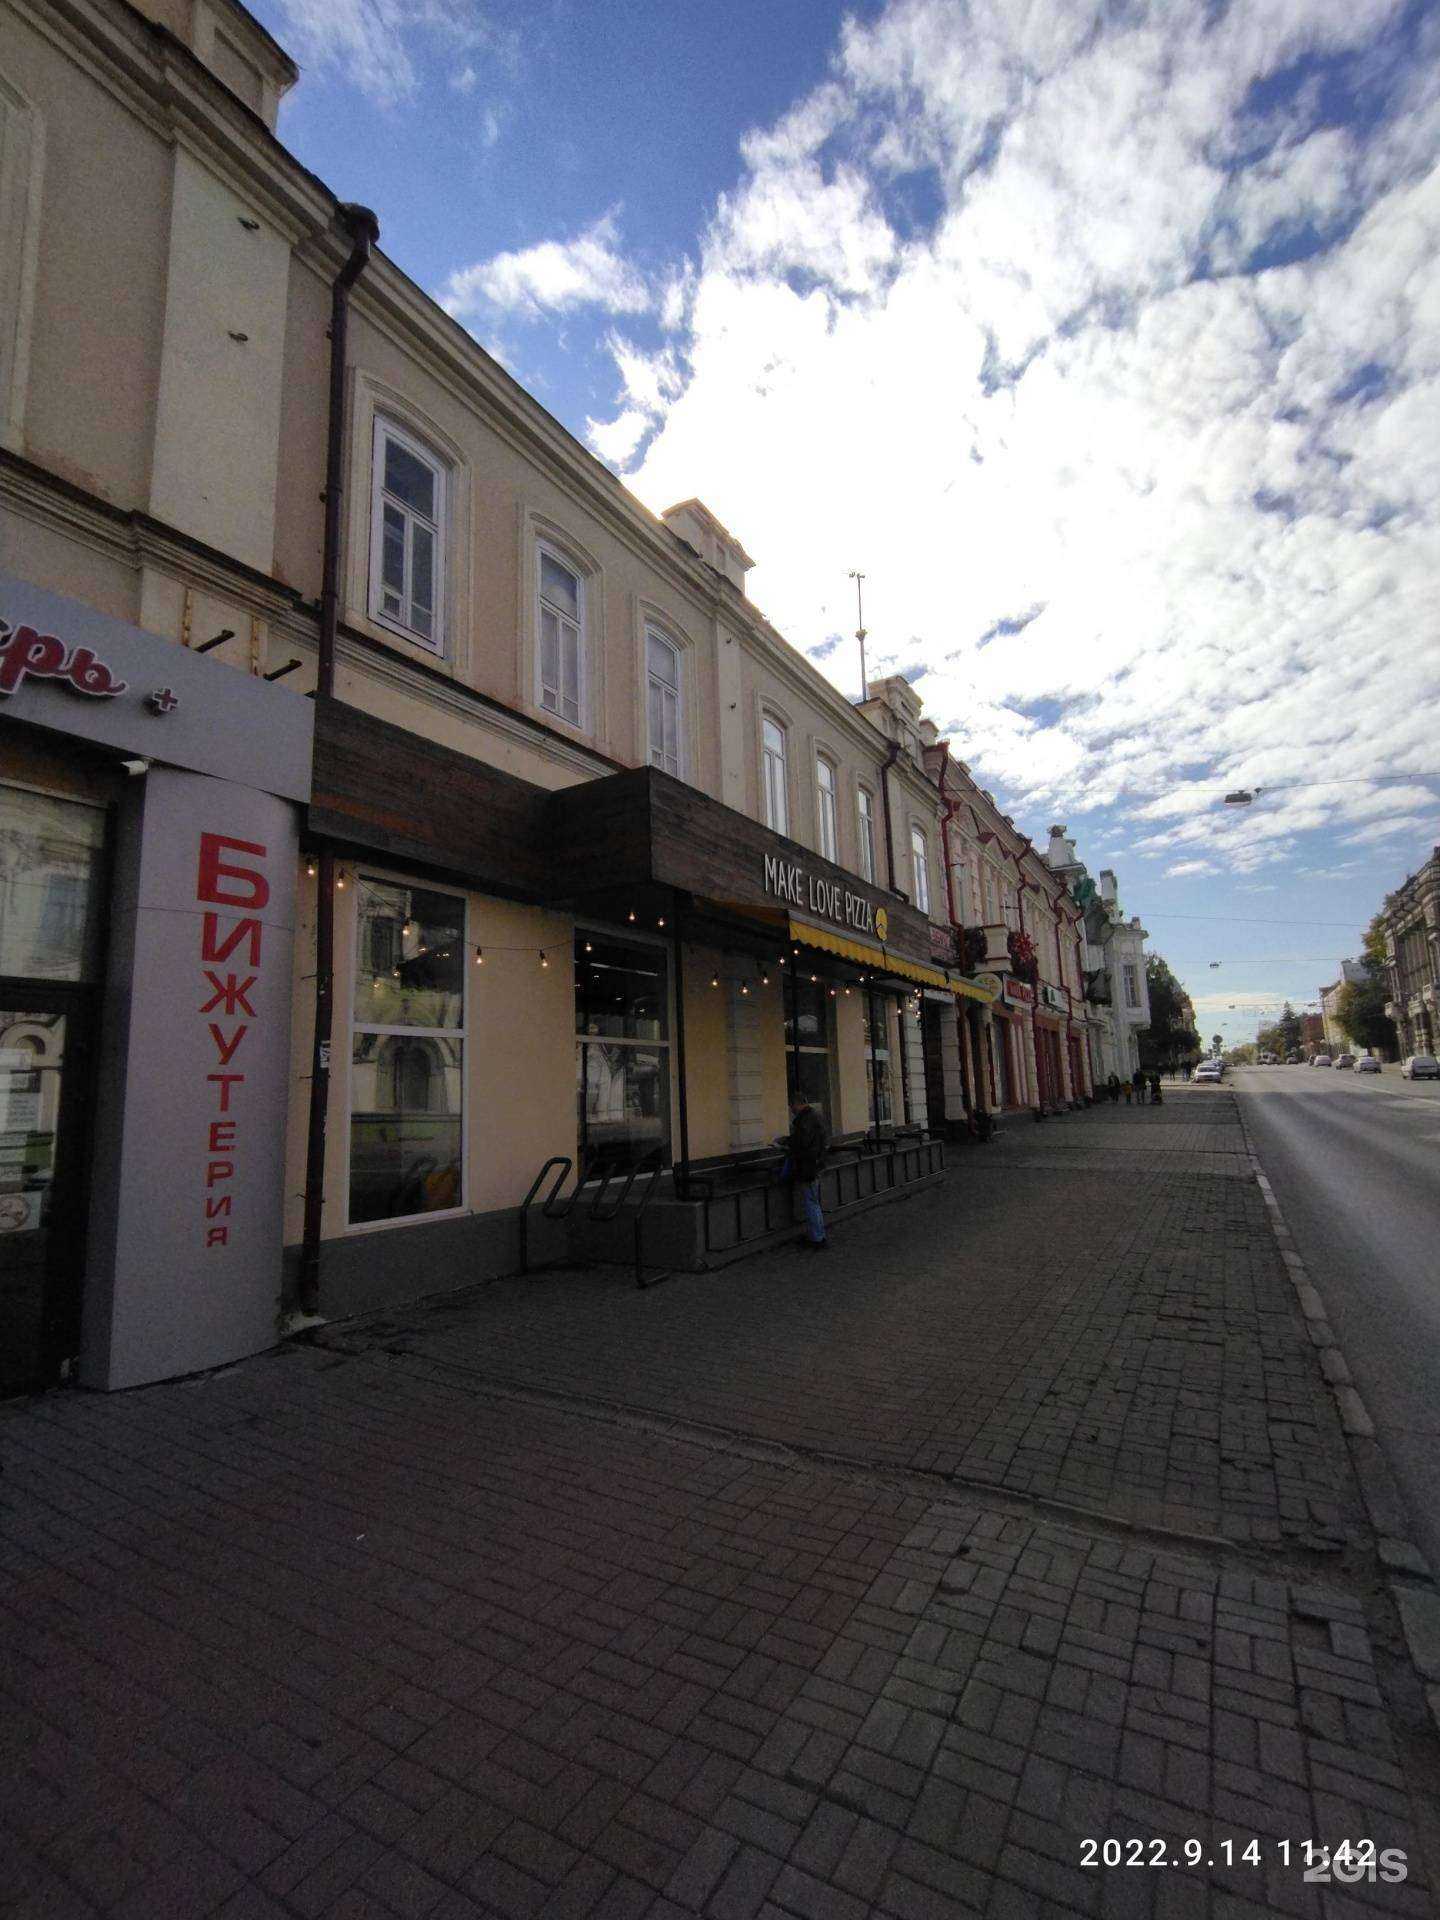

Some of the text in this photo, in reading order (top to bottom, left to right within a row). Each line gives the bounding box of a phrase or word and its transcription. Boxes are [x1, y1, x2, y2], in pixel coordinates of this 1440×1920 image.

[0, 617, 129, 696] рь
[764, 853, 874, 933] MAKE LOVE PIZZA
[197, 832, 270, 1247] БИЖУТЕРИЯ
